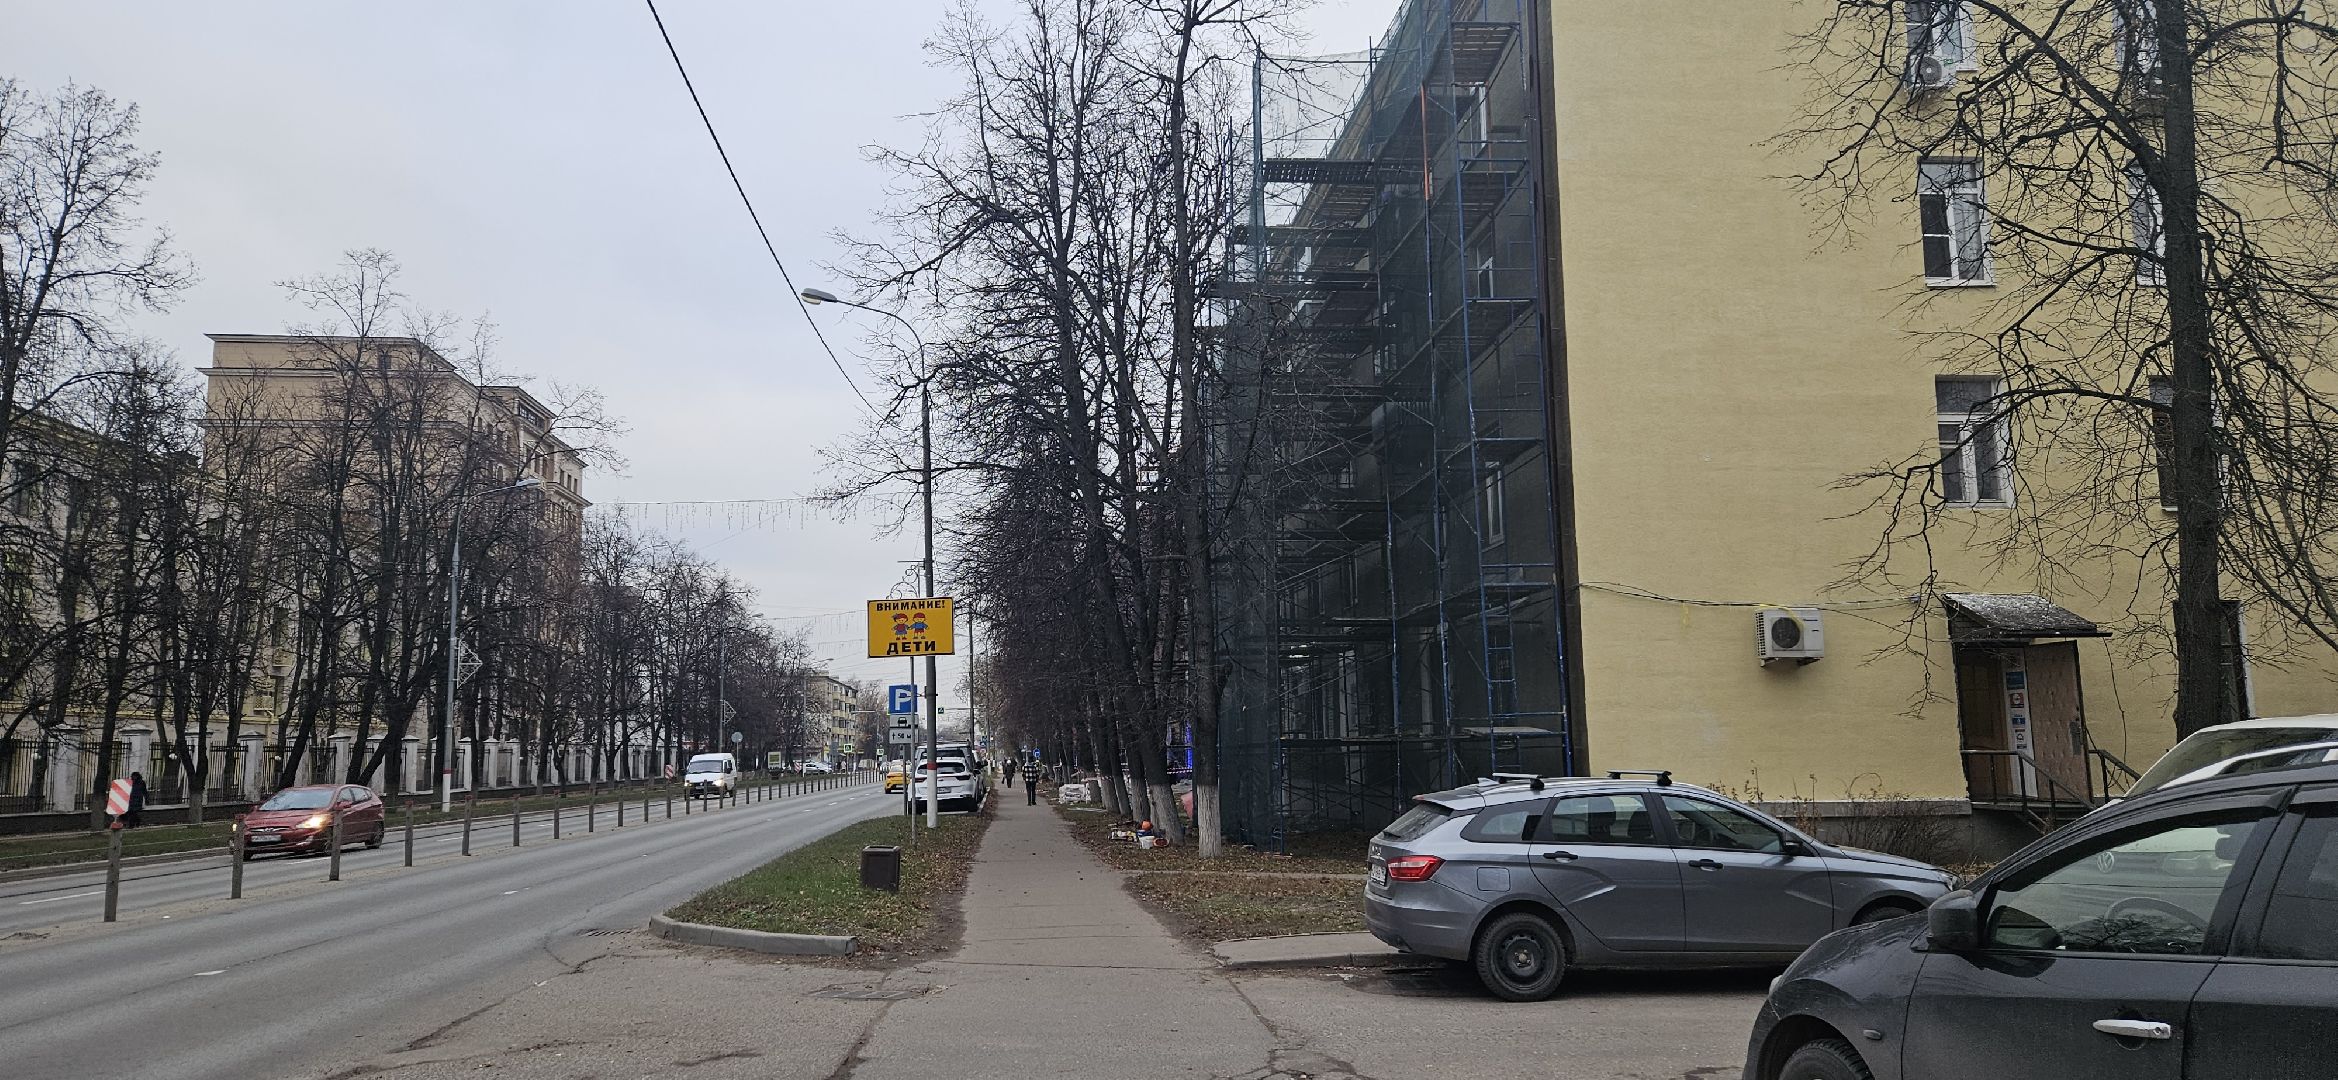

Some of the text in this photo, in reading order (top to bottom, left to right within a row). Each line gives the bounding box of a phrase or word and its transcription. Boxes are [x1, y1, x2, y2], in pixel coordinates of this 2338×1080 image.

[876, 600, 945, 611] ВНИМАНИЕ!
[887, 641, 936, 655] ДЕТИ
[895, 689, 912, 711] P
